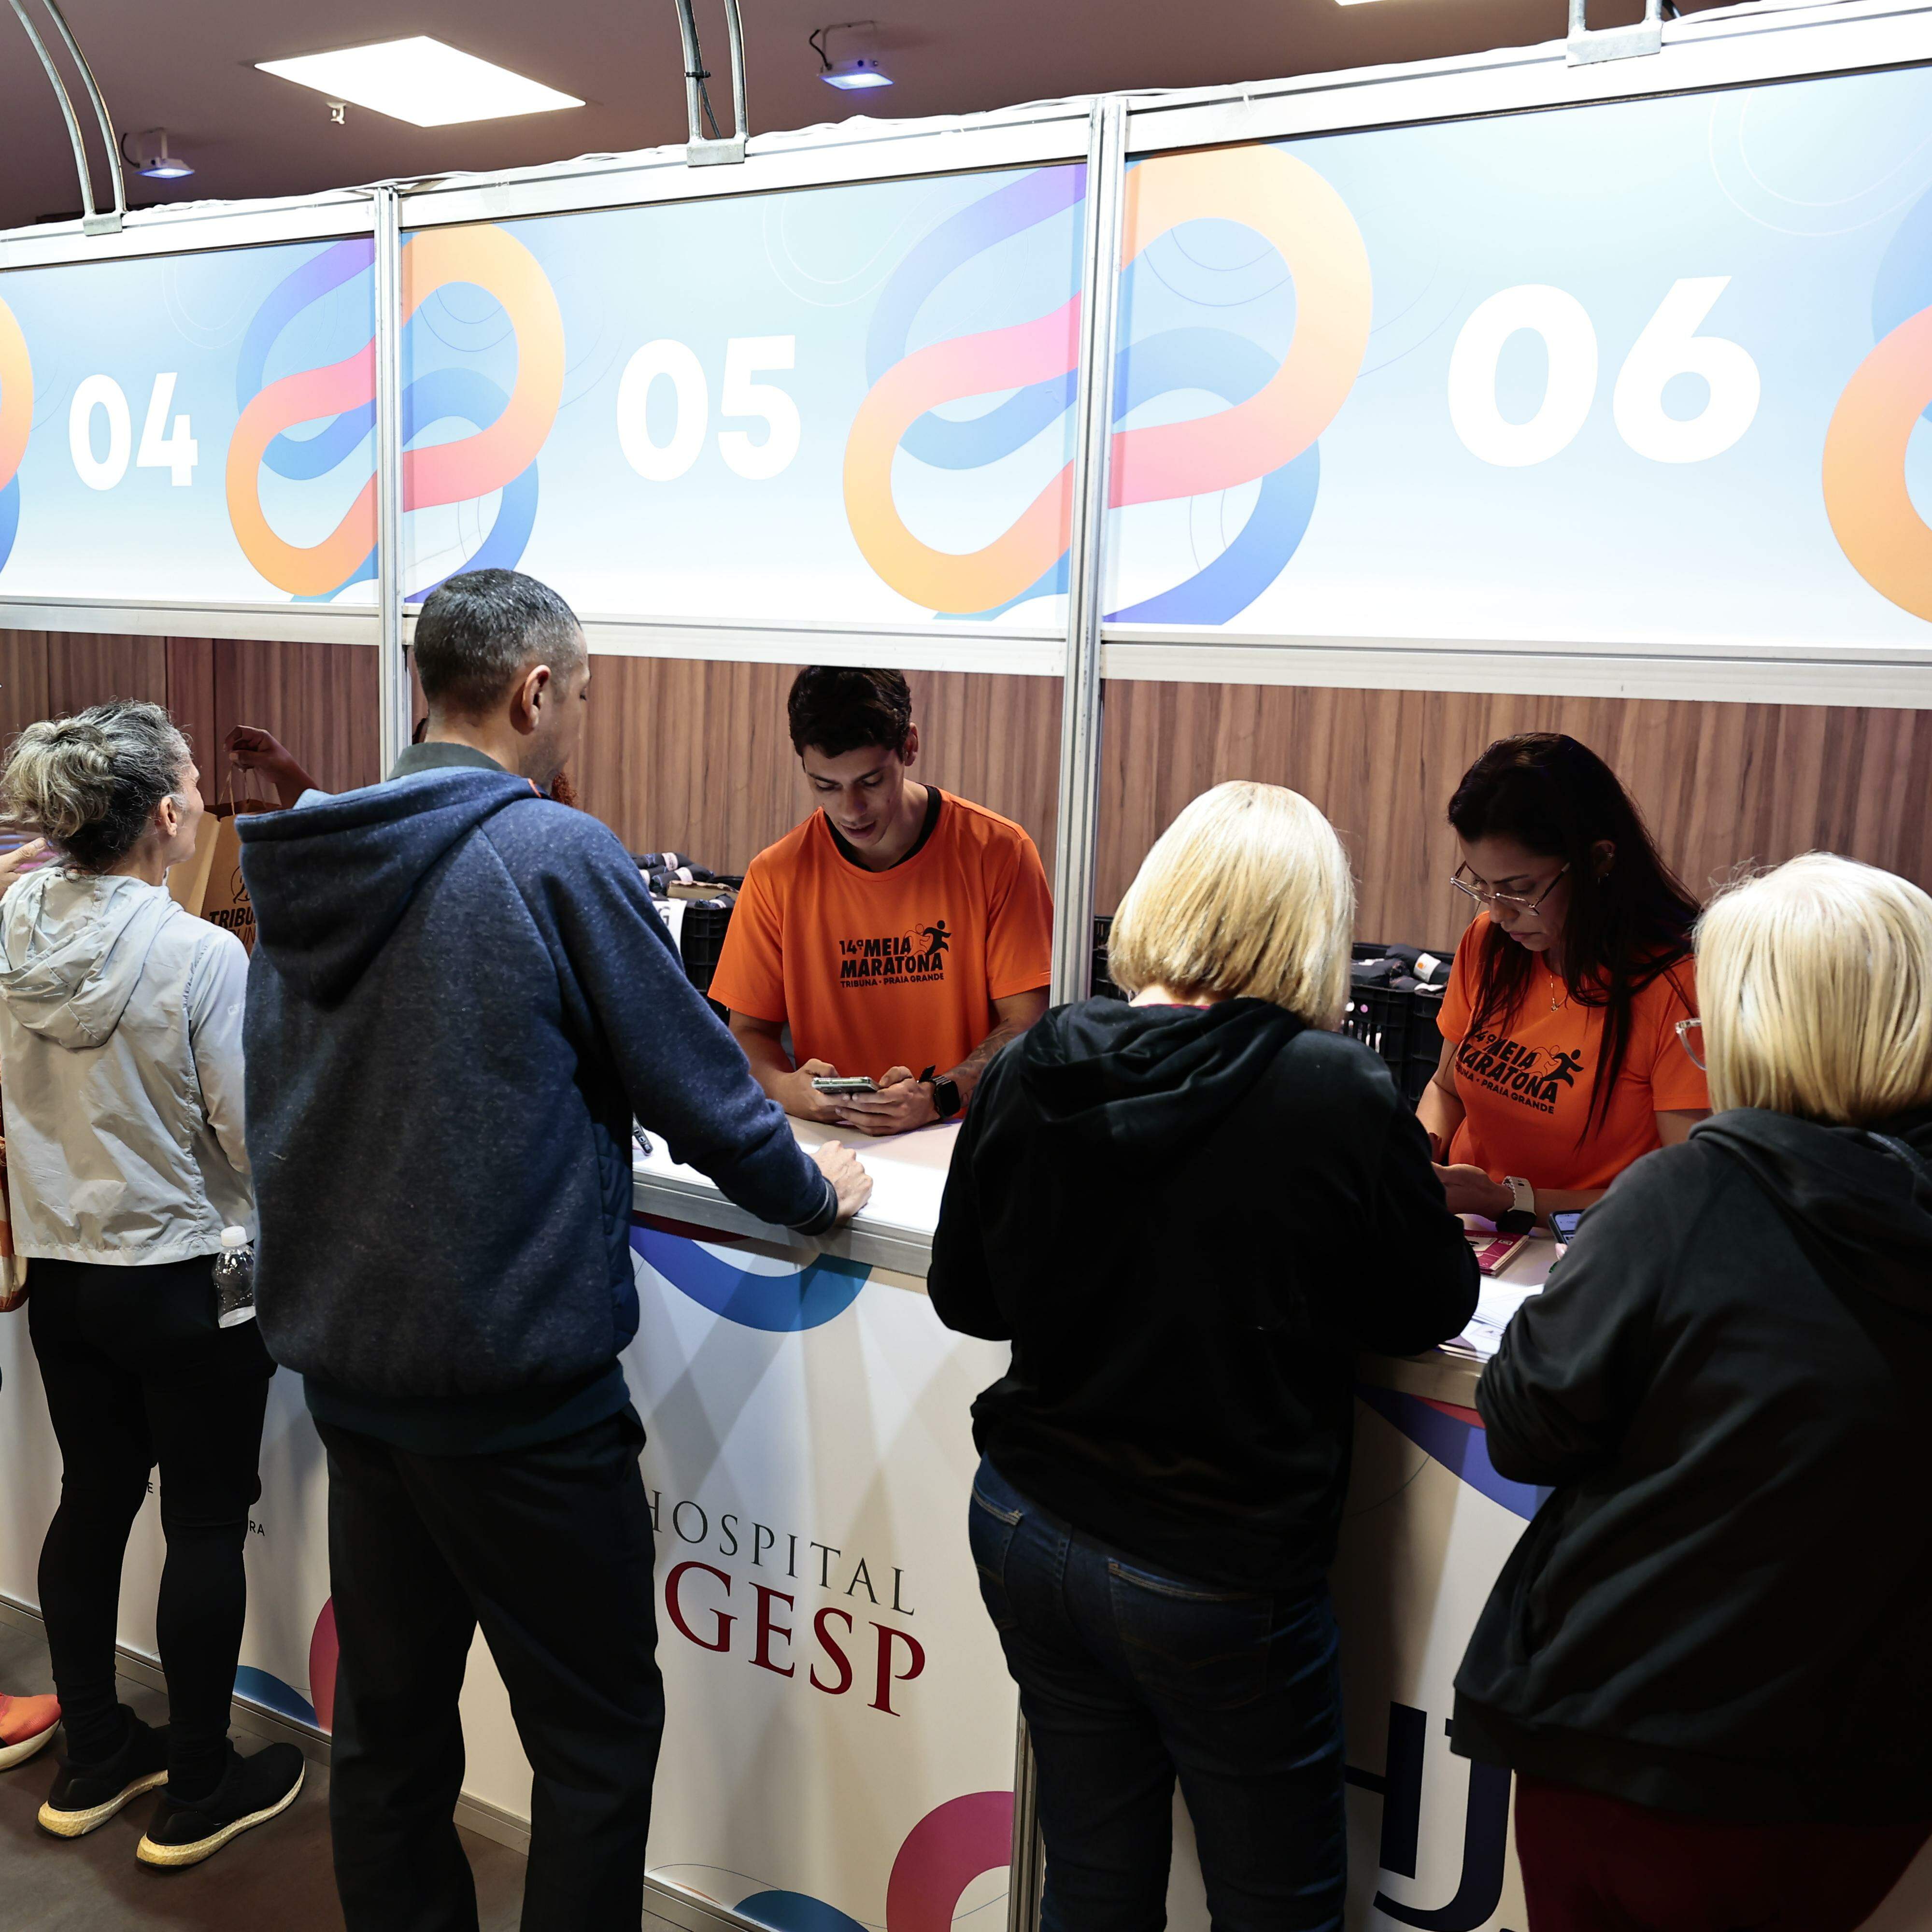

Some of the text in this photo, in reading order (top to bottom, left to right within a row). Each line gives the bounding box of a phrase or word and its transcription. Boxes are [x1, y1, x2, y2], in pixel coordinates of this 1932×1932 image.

[1448, 275, 1761, 468] 06
[616, 334, 801, 482] 05
[69, 371, 199, 491] 04
[209, 906, 256, 929] TRIBU
[840, 952, 943, 979] MARATONA
[864, 937, 911, 957] MEIA
[840, 973, 944, 988] TRIBUNA PRAIA GRANDE
[1481, 1078, 1509, 1098] PRAIA
[1511, 1092, 1555, 1115] GRANDE
[665, 1561, 925, 1717] GESP
